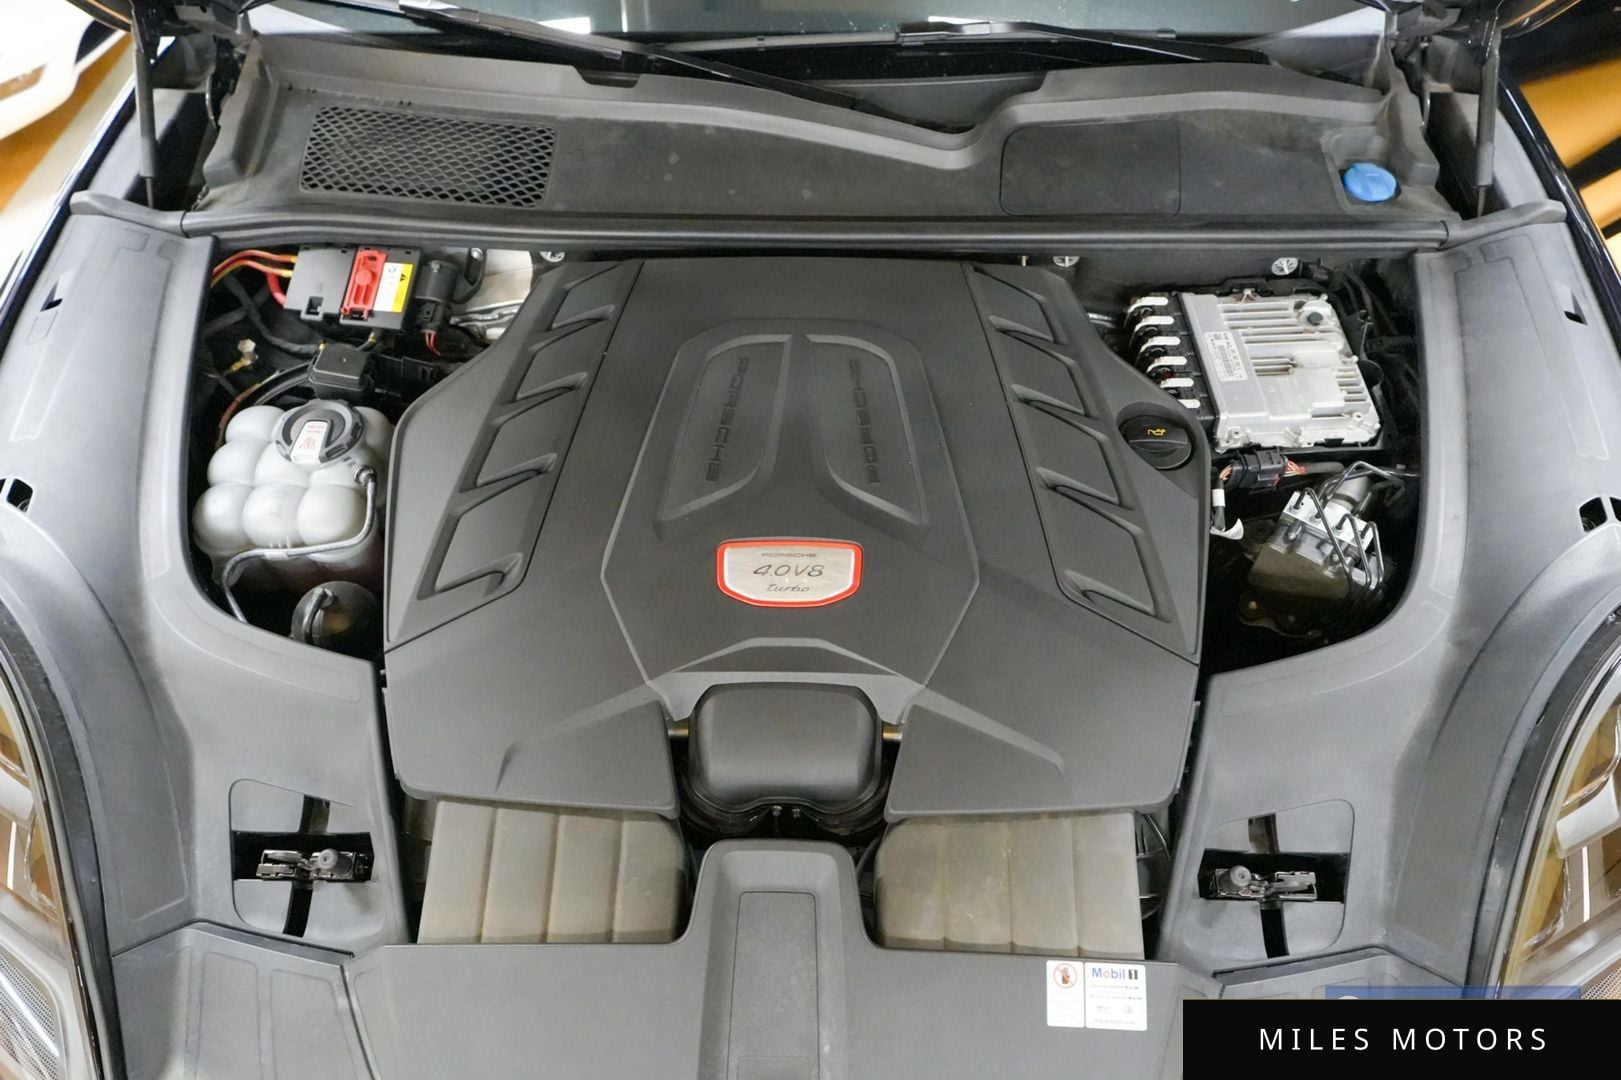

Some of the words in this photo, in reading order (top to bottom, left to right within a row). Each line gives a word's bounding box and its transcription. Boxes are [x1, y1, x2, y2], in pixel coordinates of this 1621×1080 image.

[705, 357, 750, 482] PORSCHE
[766, 583, 811, 593] turbo
[1092, 967, 1126, 980] Mobil
